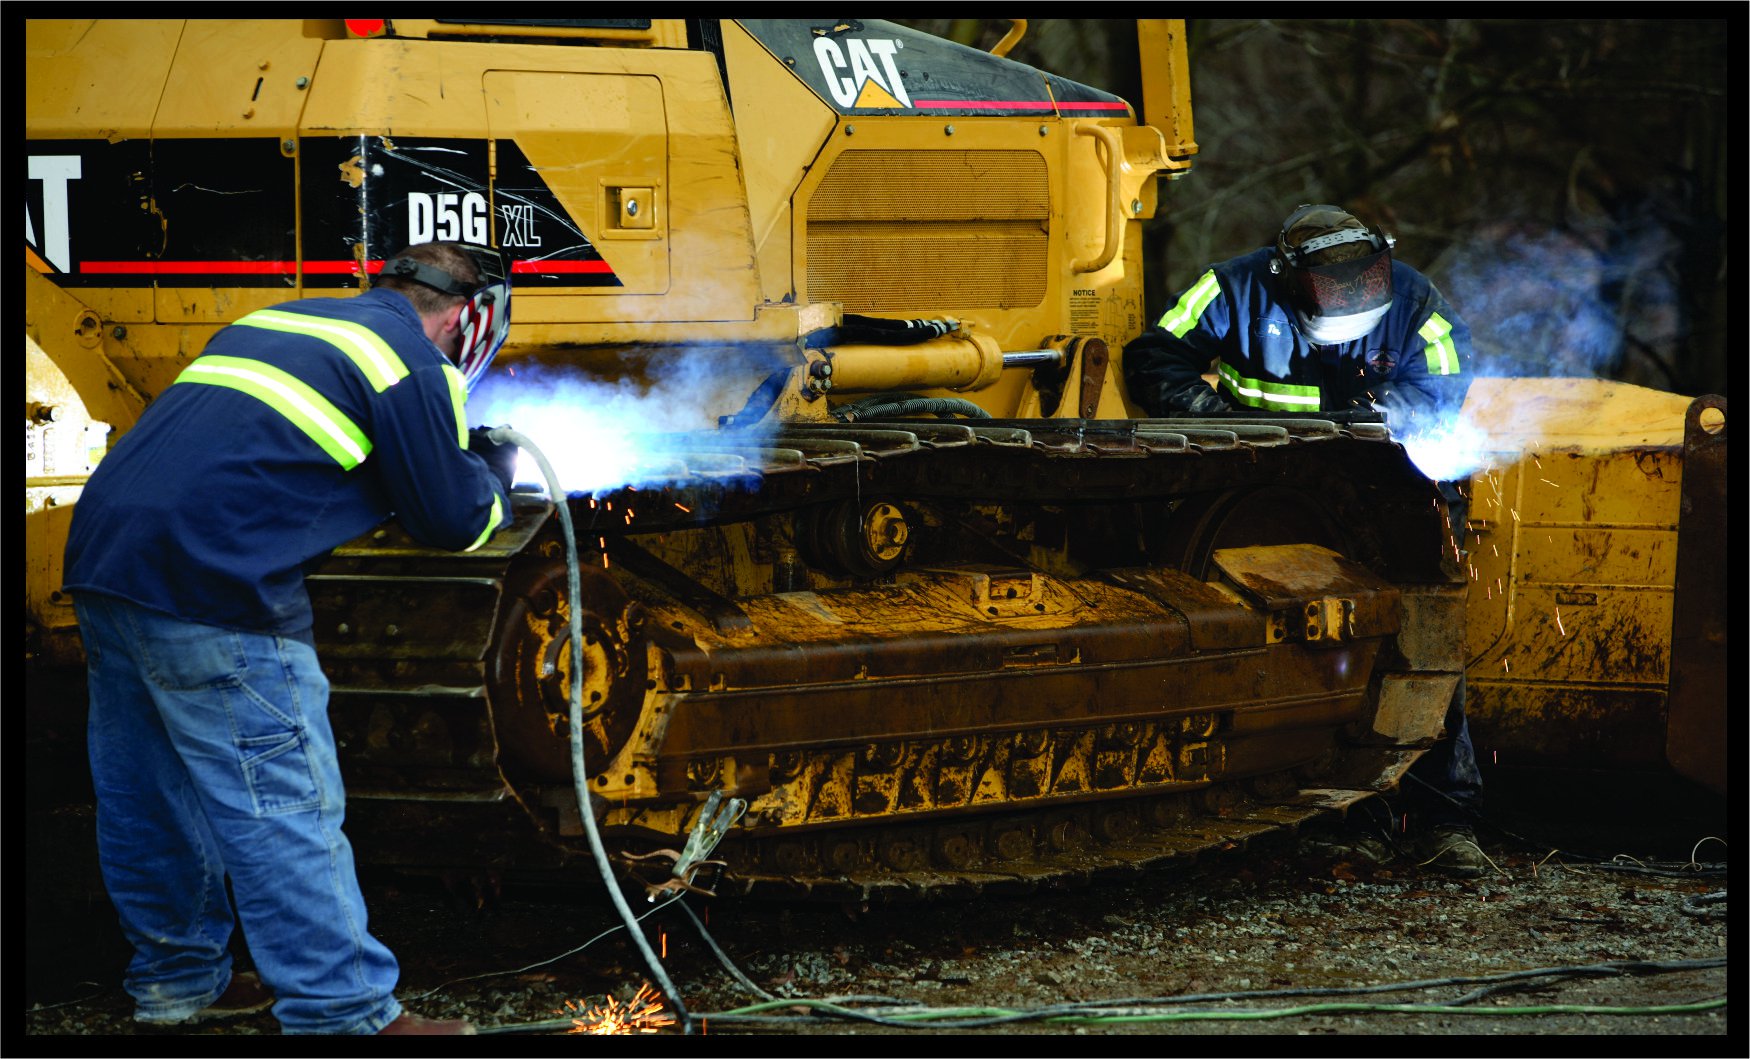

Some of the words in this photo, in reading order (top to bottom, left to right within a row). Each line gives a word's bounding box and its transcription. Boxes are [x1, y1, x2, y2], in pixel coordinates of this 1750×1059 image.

[26, 155, 81, 273] T
[408, 192, 487, 246] D5G
[502, 205, 541, 246] XL
